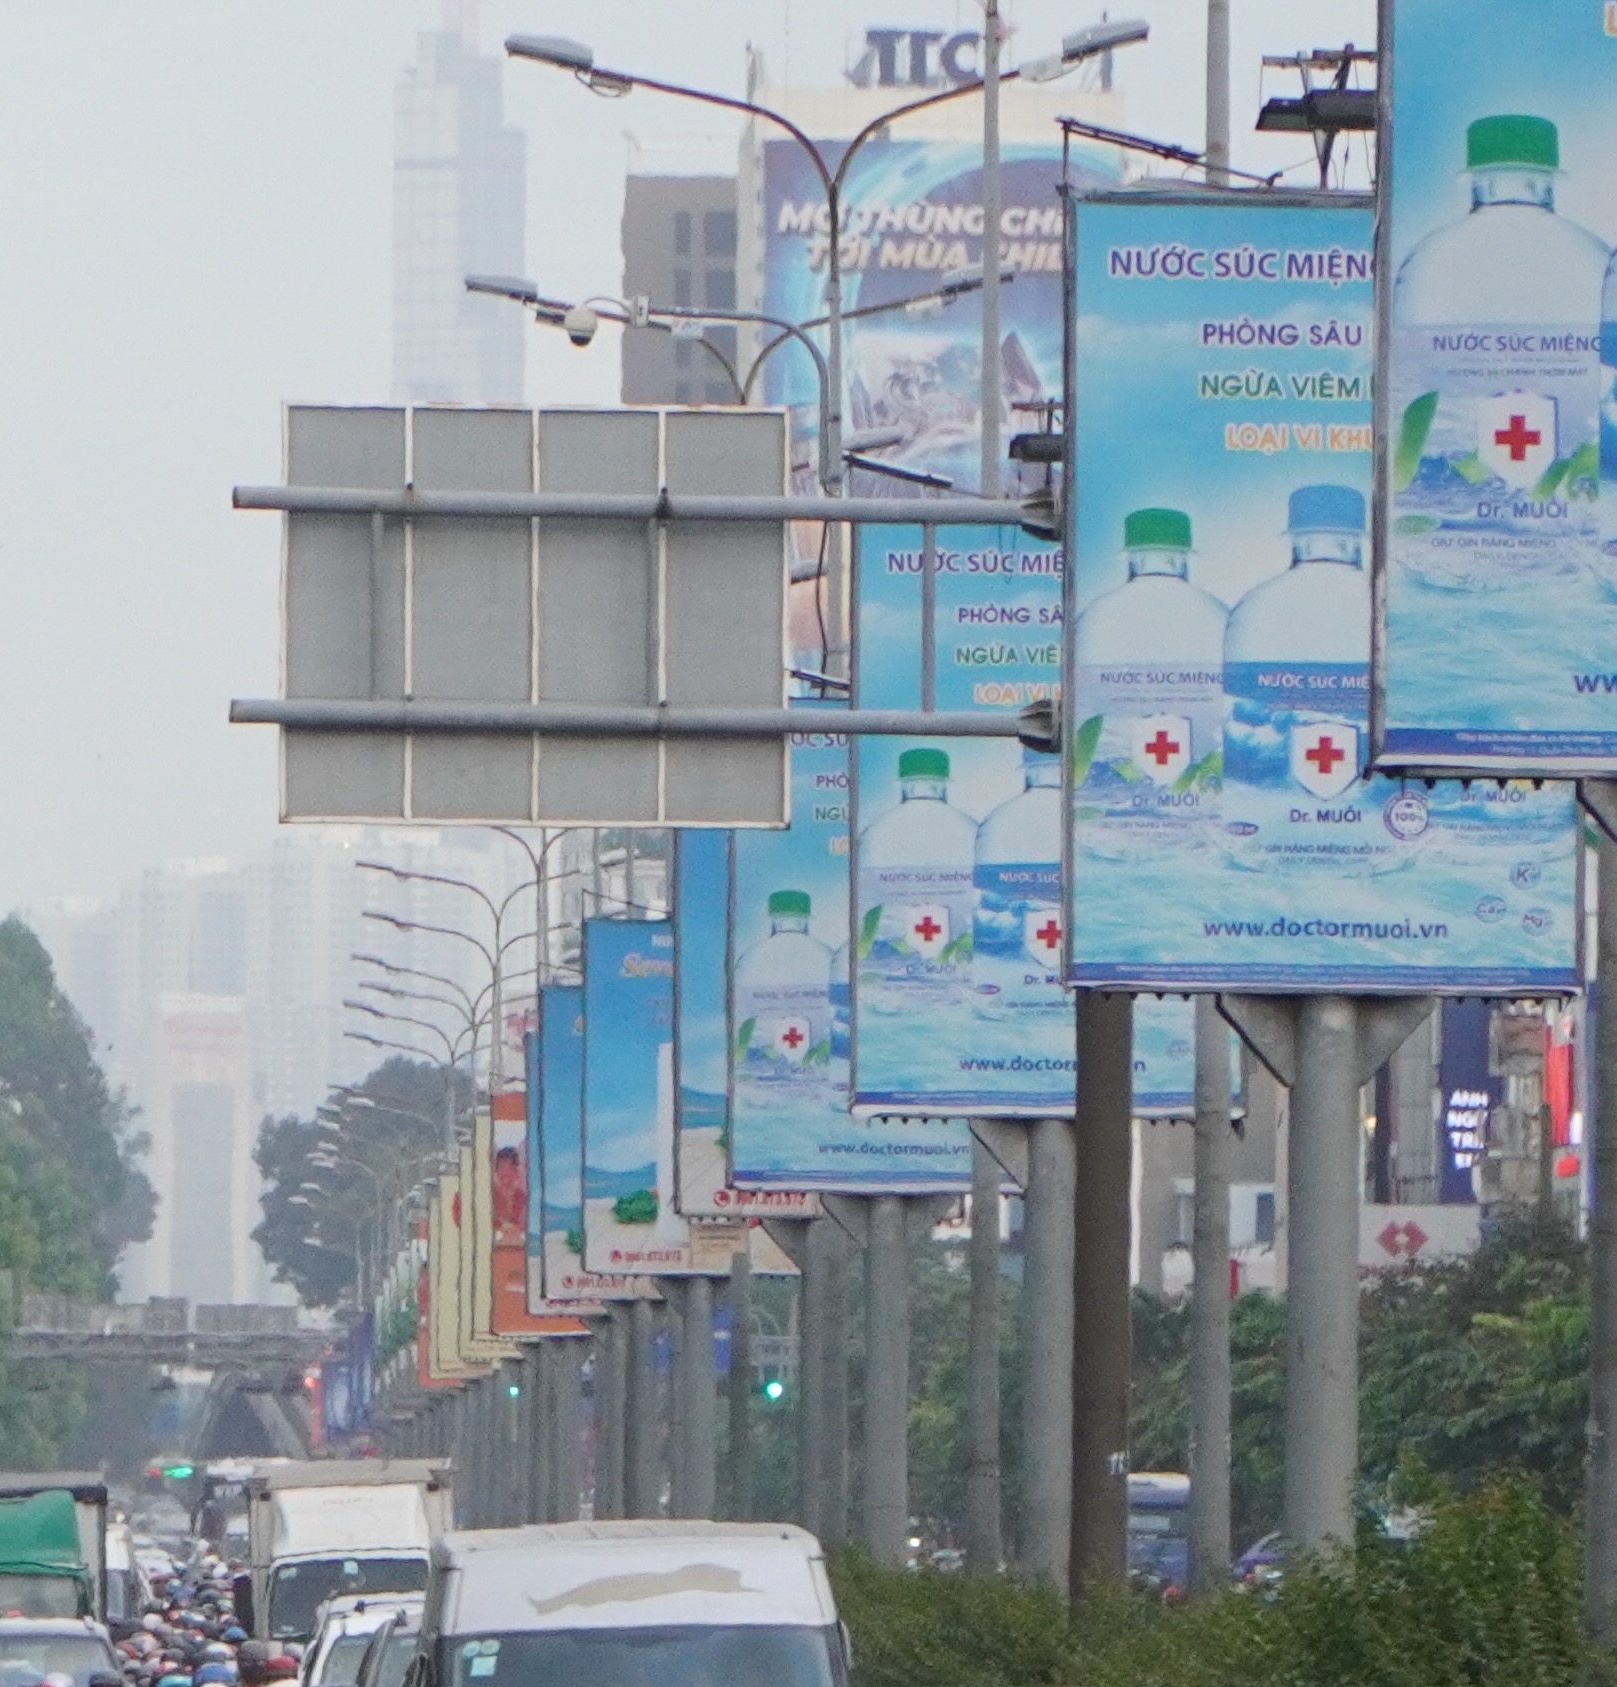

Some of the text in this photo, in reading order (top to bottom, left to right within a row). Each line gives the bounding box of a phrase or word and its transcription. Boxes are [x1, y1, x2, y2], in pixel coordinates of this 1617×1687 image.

[1110, 246, 1206, 277] NƯỚC
[1215, 247, 1278, 279] SÚC
[1202, 318, 1362, 346] PHÒNG SÂU
[1433, 332, 1492, 352] NƯỚC
[1200, 369, 1360, 399] NGỪA VIÊM
[1226, 425, 1287, 453] LOẠI
[1294, 426, 1320, 448] VI
[967, 550, 1015, 573] SÚC
[957, 604, 1031, 624] PHÒNG
[956, 642, 1019, 664] NGỪA
[1316, 805, 1362, 823] MUỐI
[1203, 916, 1449, 940] www.doctormuoi.vn
